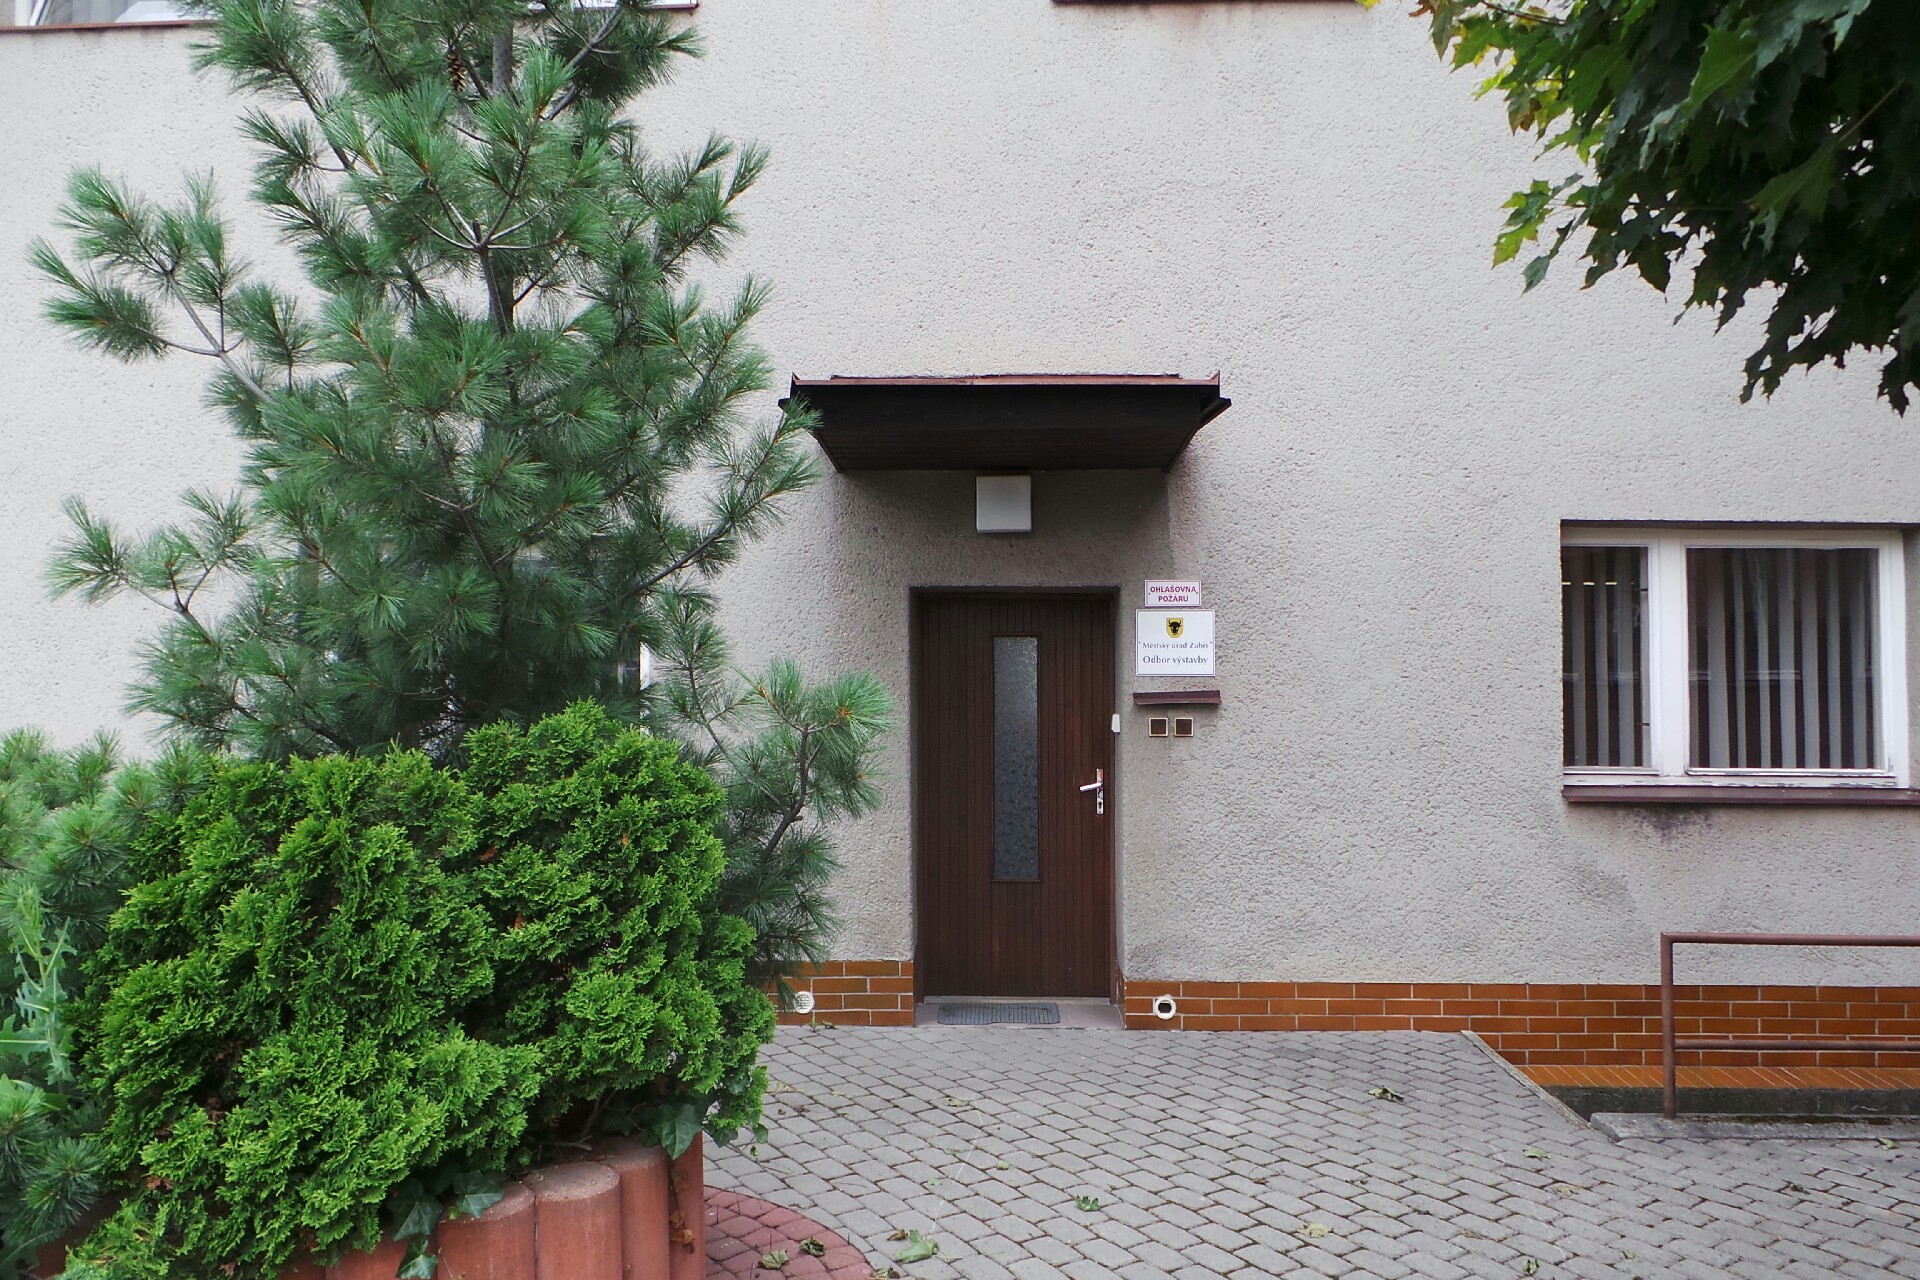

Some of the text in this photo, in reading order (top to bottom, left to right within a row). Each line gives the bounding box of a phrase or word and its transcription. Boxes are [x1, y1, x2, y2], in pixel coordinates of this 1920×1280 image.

[1150, 585, 1196, 593] OHLAŠOVNA
[1158, 594, 1189, 602] POŽÁRU
[1143, 655, 1208, 665] Odbor výstavby
